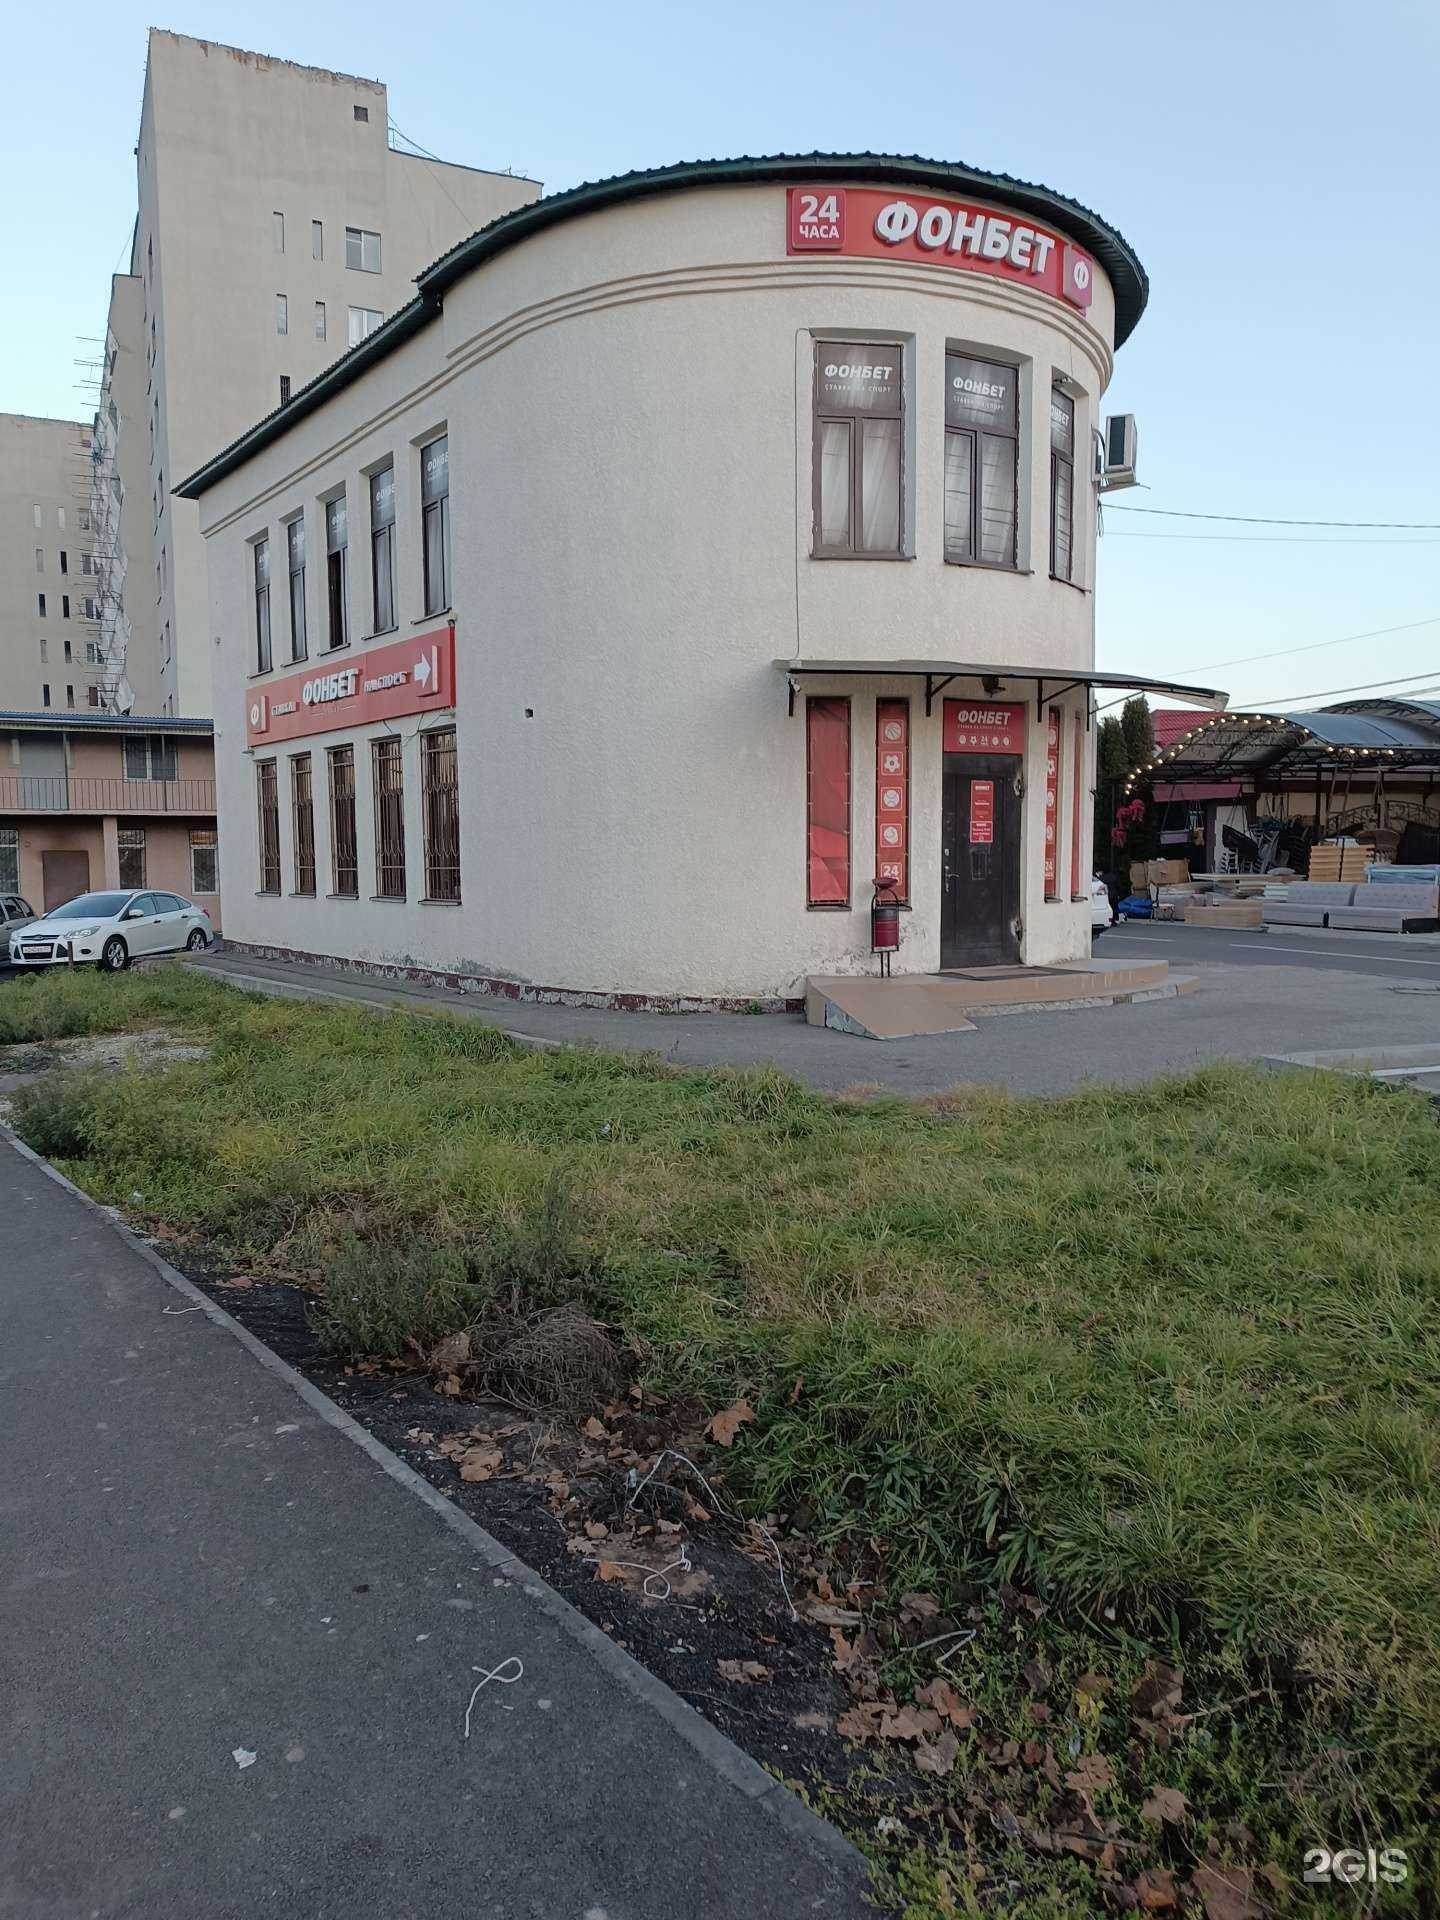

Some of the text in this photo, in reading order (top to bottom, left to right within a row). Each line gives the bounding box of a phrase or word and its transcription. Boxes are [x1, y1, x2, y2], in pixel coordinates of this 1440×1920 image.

[800, 195, 839, 222] 24
[799, 225, 839, 238] ЧАСА
[874, 201, 1055, 274] ФОНБЕТ
[824, 364, 892, 380] ФОНБЕТ
[953, 377, 1005, 398] ФОНБЕТ
[303, 668, 359, 706] ФОНБЕТ
[958, 710, 1011, 725] ФОНБЕТ
[883, 864, 900, 878] 24
